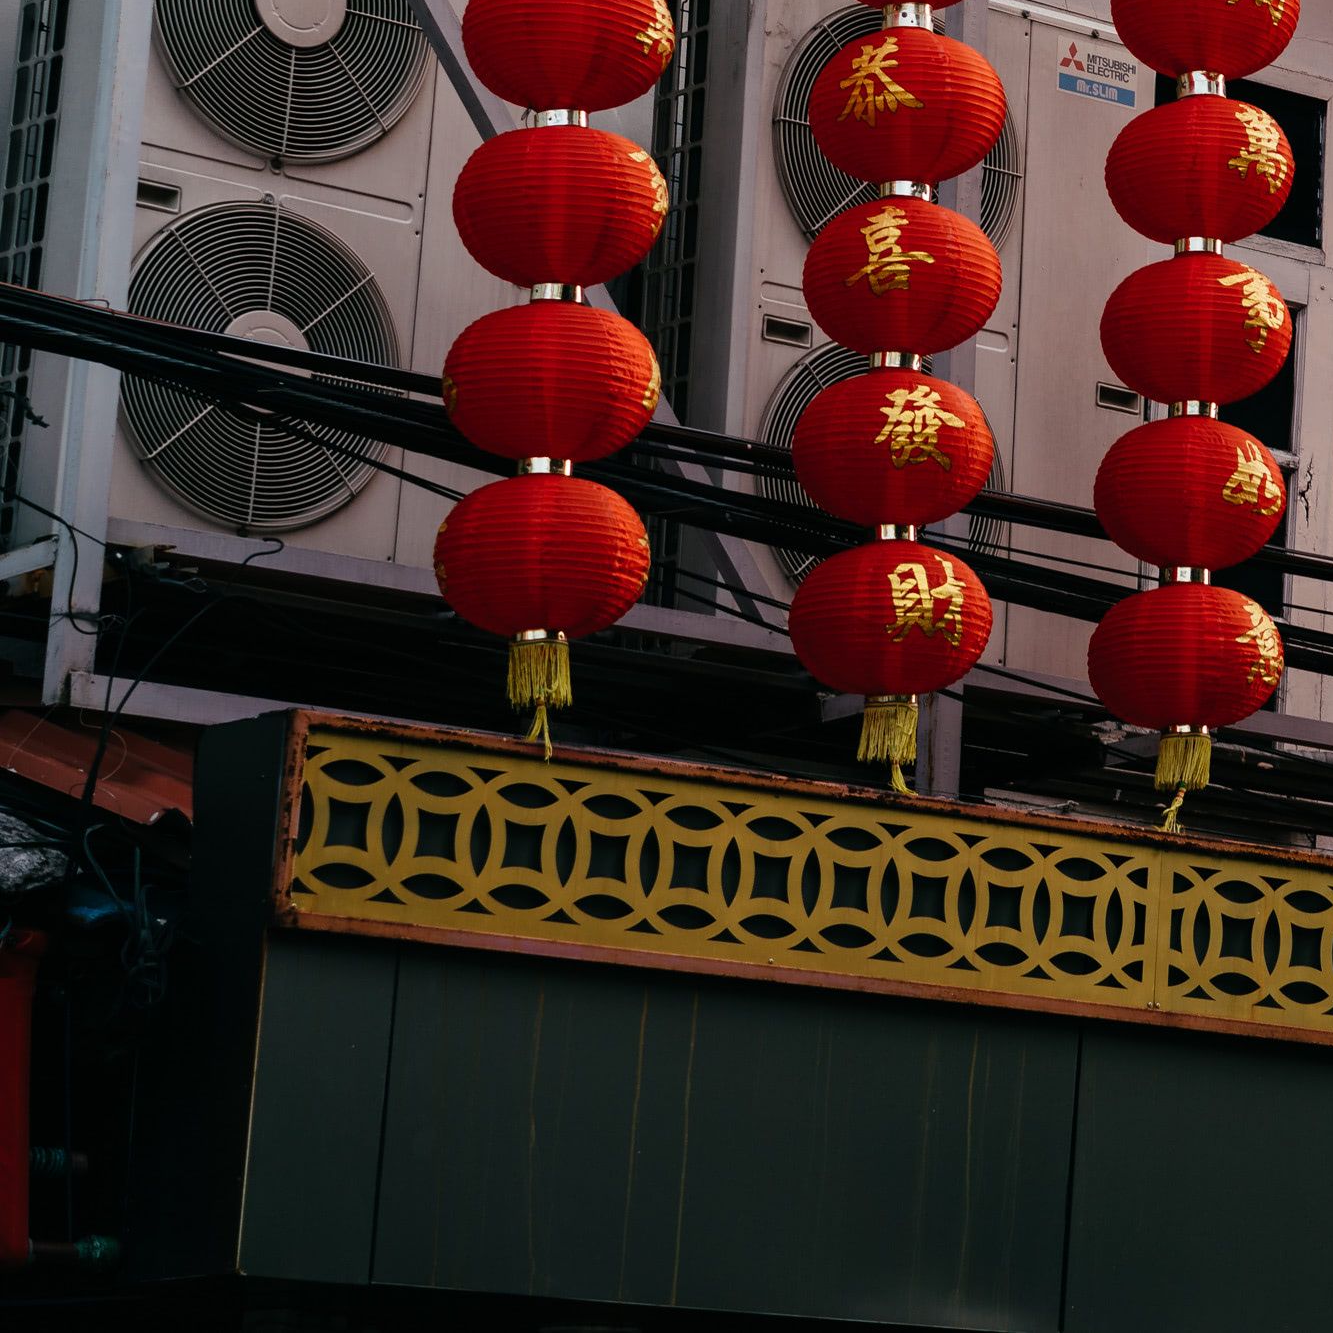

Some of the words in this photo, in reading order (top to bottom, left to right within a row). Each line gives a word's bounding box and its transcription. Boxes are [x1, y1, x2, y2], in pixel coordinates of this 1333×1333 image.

[836, 35, 925, 128] 恭
[1086, 52, 1137, 75] MITSUBISHI
[1086, 63, 1130, 84] ELECTRIC
[1227, 102, 1290, 196] 萬
[843, 204, 936, 298] 喜
[1217, 262, 1287, 355] 事
[873, 382, 968, 473] 發
[1221, 438, 1284, 517] 如
[884, 553, 969, 650] 財
[1234, 594, 1286, 688] 意
